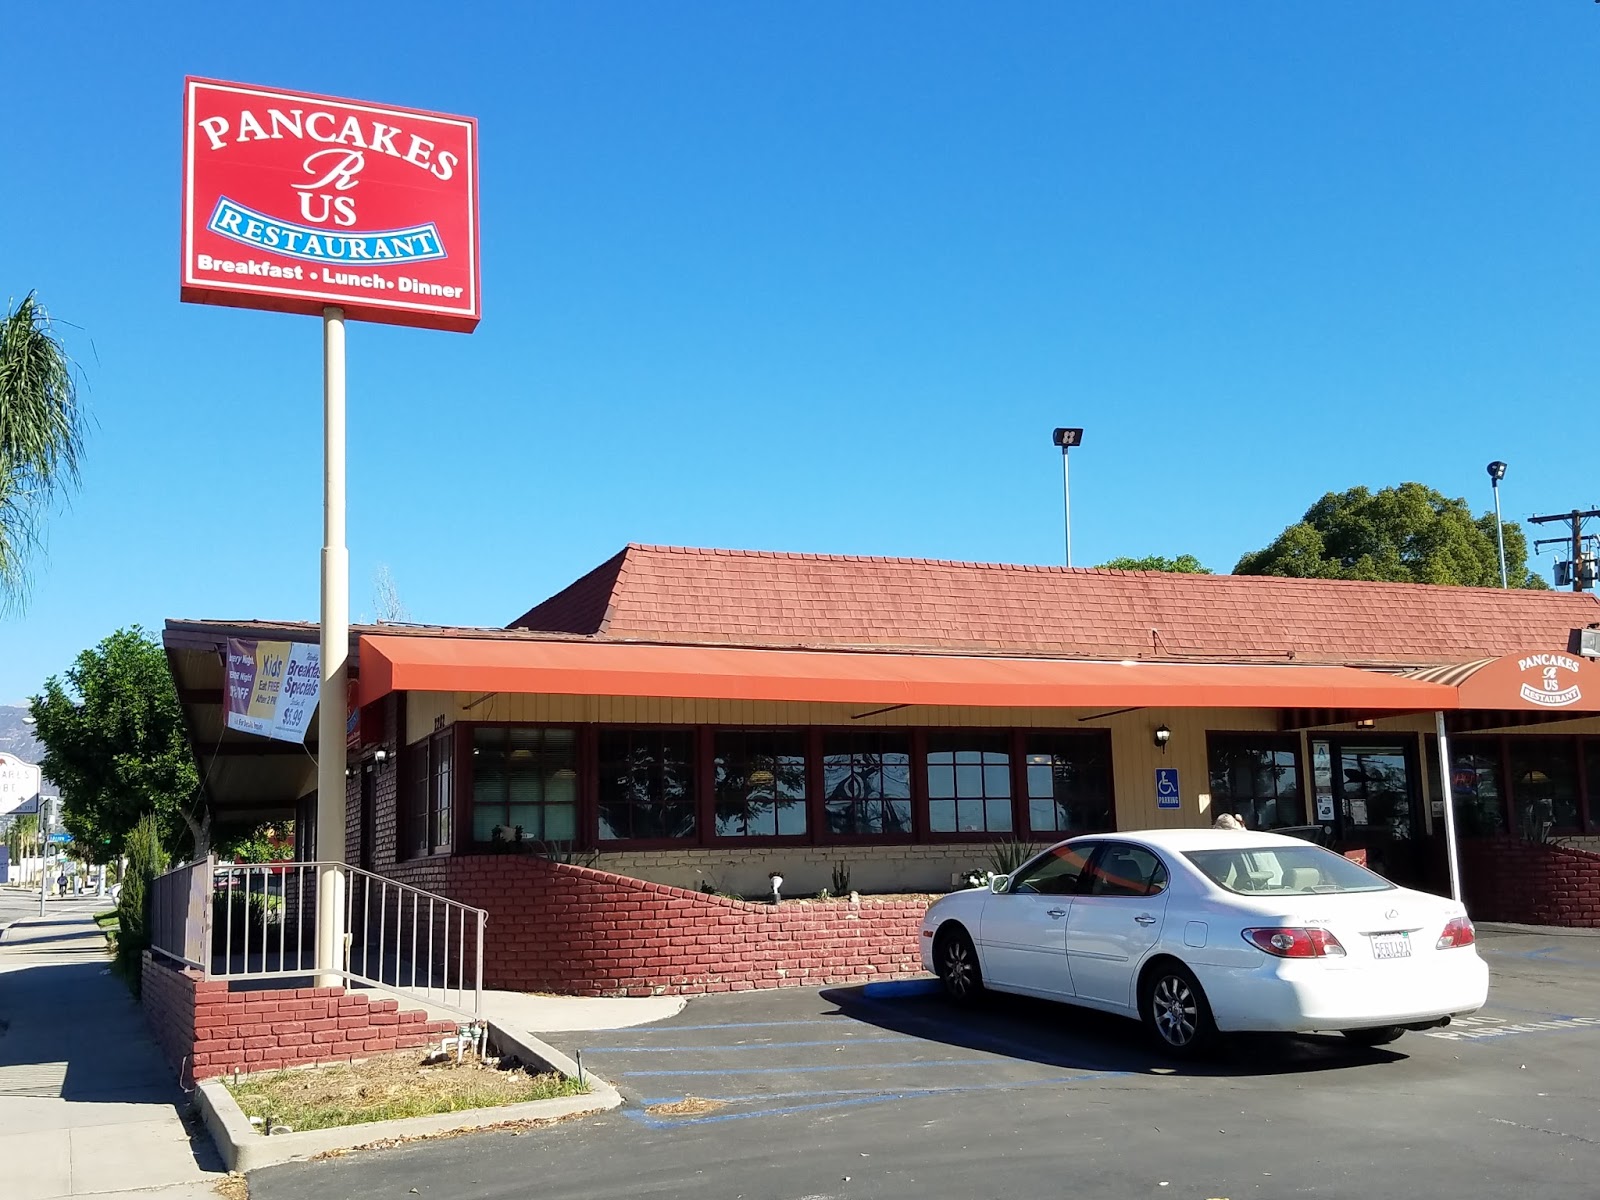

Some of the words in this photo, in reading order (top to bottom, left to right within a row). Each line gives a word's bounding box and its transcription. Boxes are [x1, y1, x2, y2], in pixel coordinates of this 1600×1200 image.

[198, 108, 459, 181] PANCAKES
[291, 148, 365, 190] R
[297, 191, 357, 226] US
[217, 207, 434, 259] RESTAURANT
[197, 254, 303, 280] Breakfast
[322, 267, 385, 290] Lunch
[398, 276, 463, 299] Dinner
[262, 654, 283, 678] Kids
[1518, 653, 1580, 672] PANCAKES
[1542, 666, 1558, 679] R
[284, 676, 319, 698] Specials
[1524, 688, 1578, 703] RESTAURANT
[1543, 679, 1559, 691] US
[1158, 796, 1179, 804] PARKING
